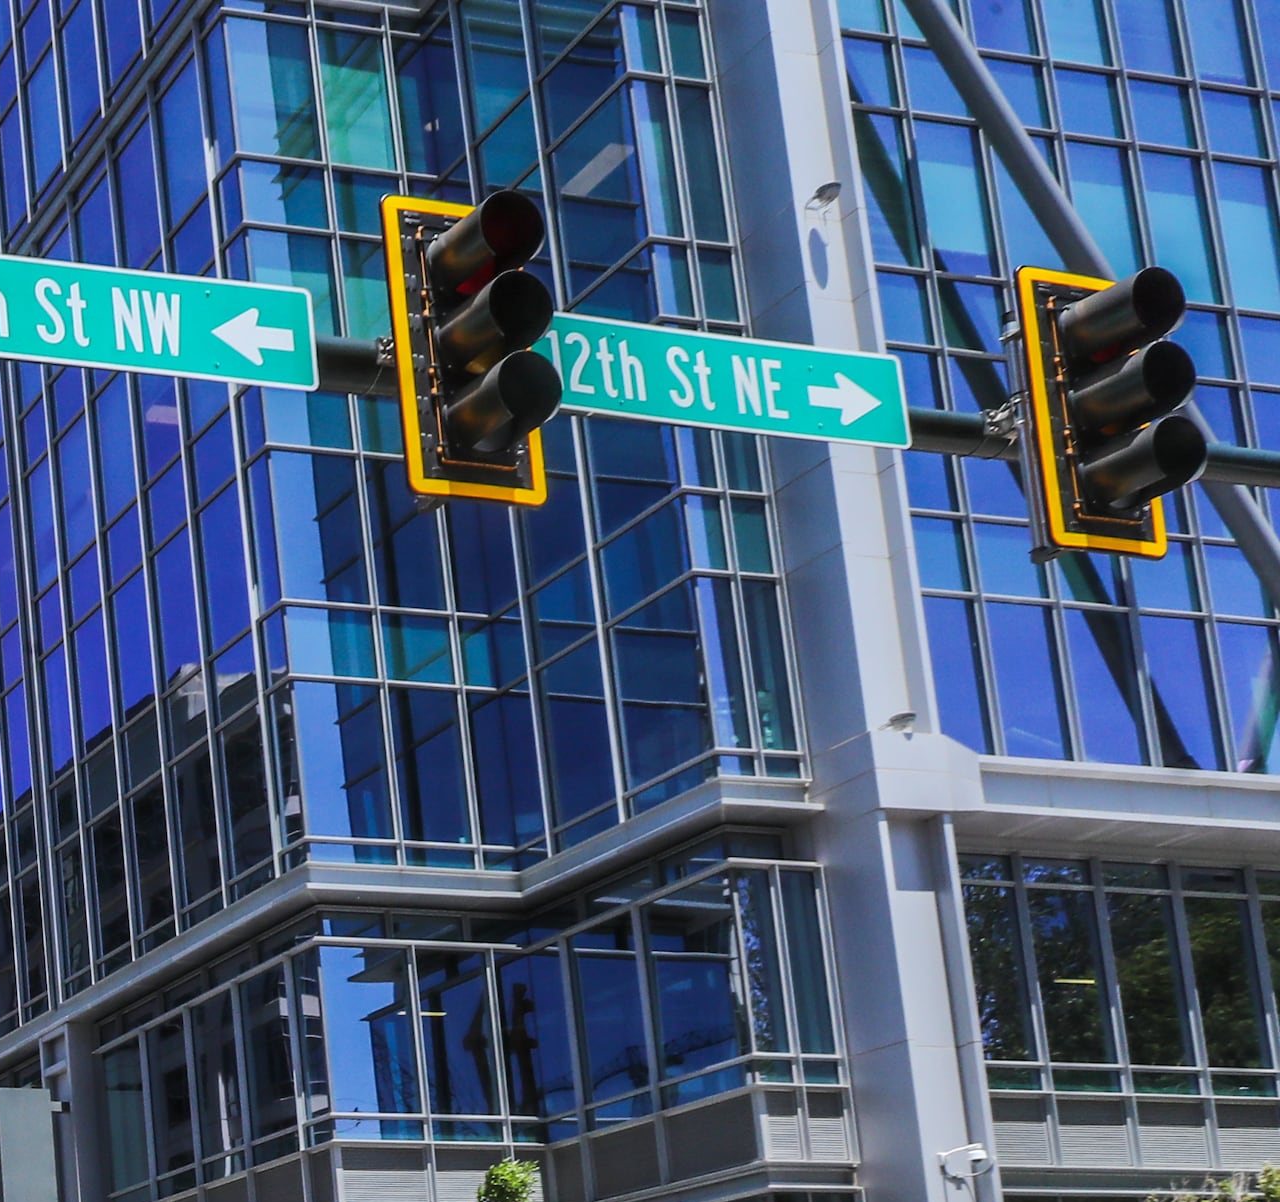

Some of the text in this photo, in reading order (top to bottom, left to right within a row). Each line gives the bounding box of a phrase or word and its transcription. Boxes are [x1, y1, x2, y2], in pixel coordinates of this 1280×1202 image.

[35, 278, 90, 348] St
[111, 286, 181, 357] NW
[545, 329, 790, 420] 12th St NE
